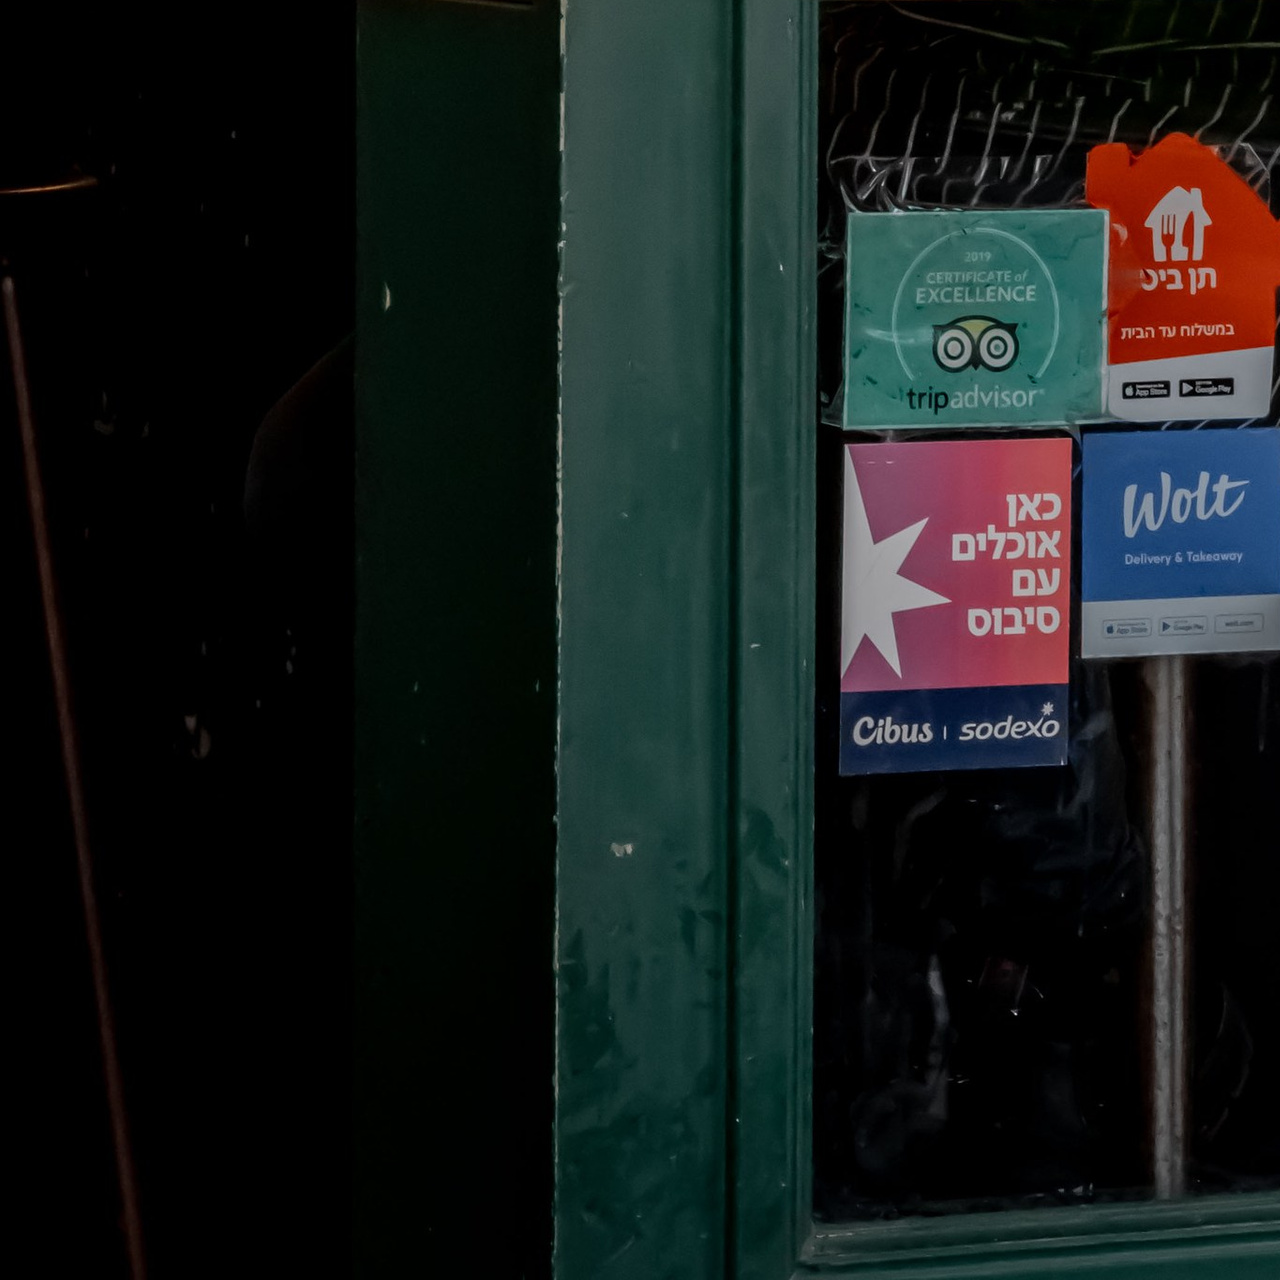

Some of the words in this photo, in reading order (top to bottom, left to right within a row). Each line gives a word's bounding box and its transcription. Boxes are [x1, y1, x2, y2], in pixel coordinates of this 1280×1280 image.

[964, 251, 992, 263] 2019
[925, 270, 1012, 284] CERTIFICATE
[1014, 269, 1029, 282] of
[1188, 267, 1217, 295] תן
[915, 285, 1037, 304] EXCELLENCE
[906, 384, 1037, 415] tripadvisor
[1006, 493, 1062, 527] כאן
[1123, 471, 1250, 538] Wolt
[952, 524, 1061, 561] אוכלים
[1125, 553, 1172, 565] Delivery
[1175, 551, 1182, 563] &
[1187, 550, 1243, 563] Takeaway
[1013, 568, 1060, 597] עם
[968, 606, 1060, 637] סיבוס
[853, 716, 934, 746] Cibus
[959, 714, 1061, 741] sodexo
